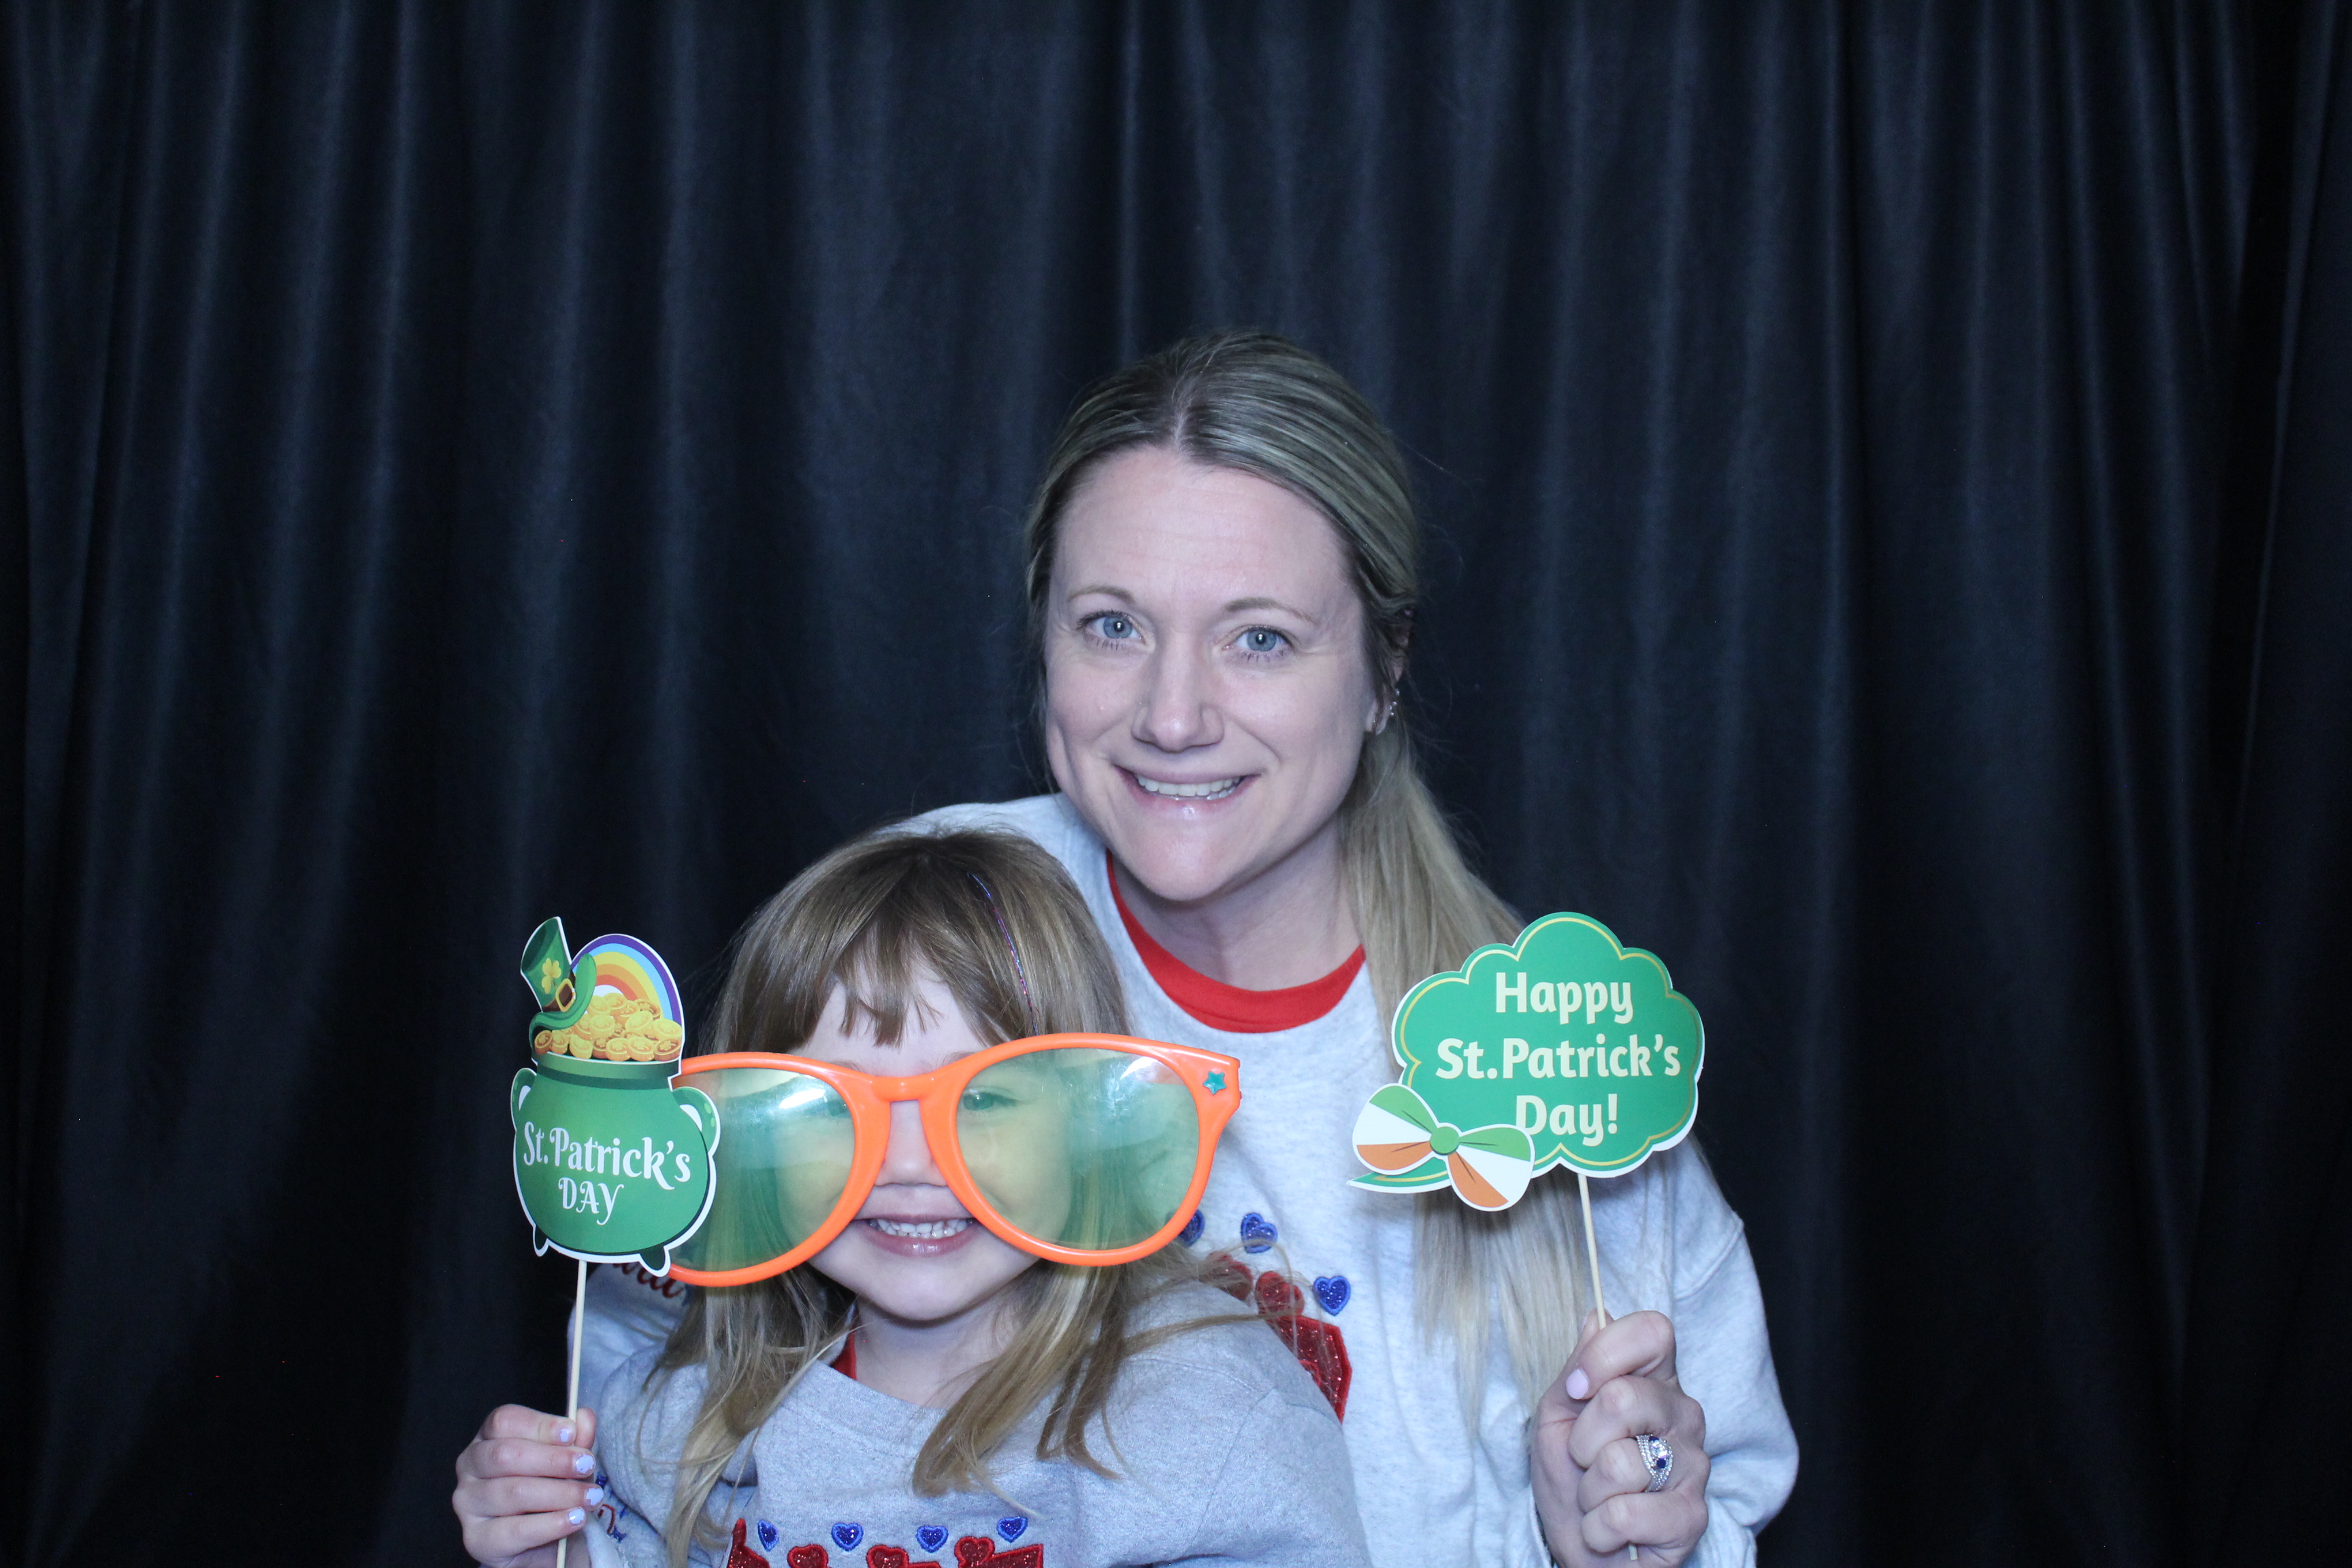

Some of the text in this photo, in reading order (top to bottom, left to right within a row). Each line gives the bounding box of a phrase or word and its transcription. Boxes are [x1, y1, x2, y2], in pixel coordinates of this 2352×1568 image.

[1495, 971, 1634, 1025] Happy
[1515, 1093, 1618, 1147] Day!
[557, 1177, 625, 1226] DAY
